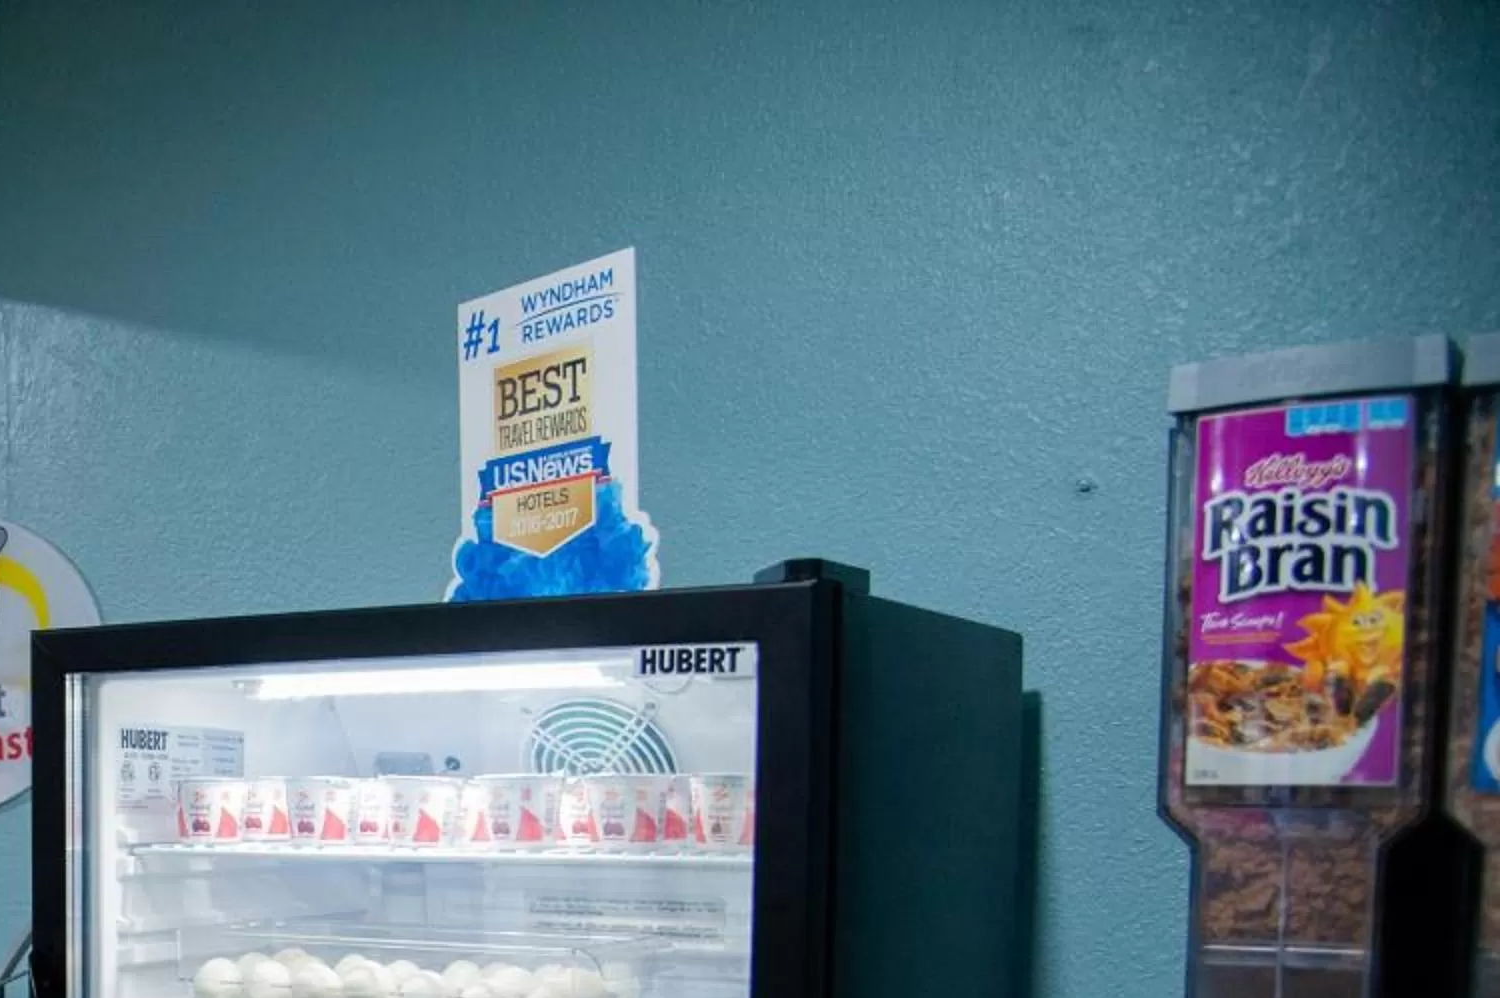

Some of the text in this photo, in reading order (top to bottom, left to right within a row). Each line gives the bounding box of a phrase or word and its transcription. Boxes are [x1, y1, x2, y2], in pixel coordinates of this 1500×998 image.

[521, 268, 614, 314] WYNDHAM
[463, 309, 501, 361] #1
[522, 299, 615, 344] REWARDS
[497, 358, 588, 421] BEST
[499, 406, 588, 450] TRAVEL REWARDS
[1244, 452, 1352, 489] Kellogg's
[516, 487, 570, 513] HOTELS
[1207, 489, 1393, 555] Raisin
[1224, 541, 1368, 597] Bran
[640, 647, 742, 675] HUBERT
[120, 728, 169, 751] HUBERT
